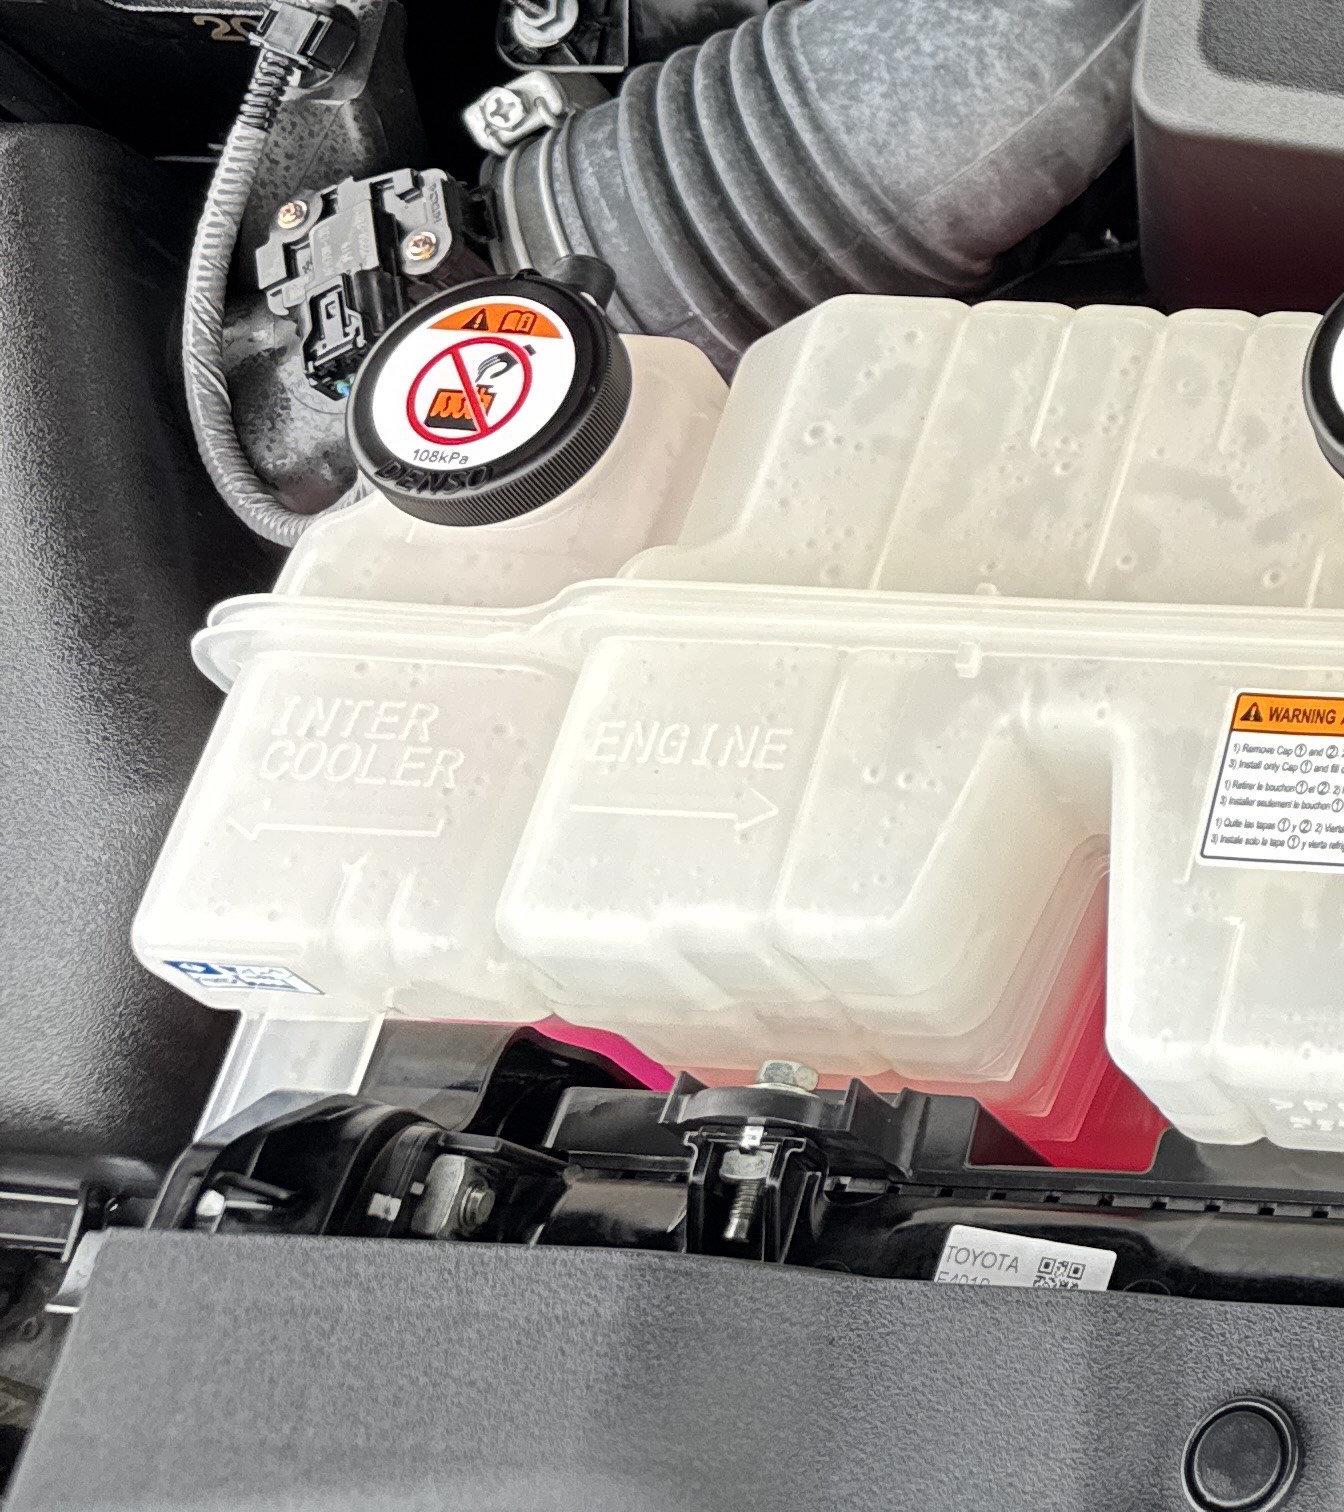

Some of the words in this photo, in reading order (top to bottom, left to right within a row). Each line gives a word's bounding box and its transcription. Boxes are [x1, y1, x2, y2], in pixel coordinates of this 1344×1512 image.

[412, 448, 469, 465] 108kPa
[378, 462, 495, 496] DENSO
[273, 694, 439, 744] INTER
[1269, 706, 1337, 726] WARNING
[592, 719, 795, 769] ENGINE
[1242, 743, 1276, 755] Remove
[1277, 745, 1294, 757] Cap
[1309, 747, 1325, 757] and
[260, 741, 466, 789] COOLER
[1282, 761, 1299, 774] Cap
[1314, 764, 1330, 773] and
[947, 1244, 1020, 1274] TOYOTA
